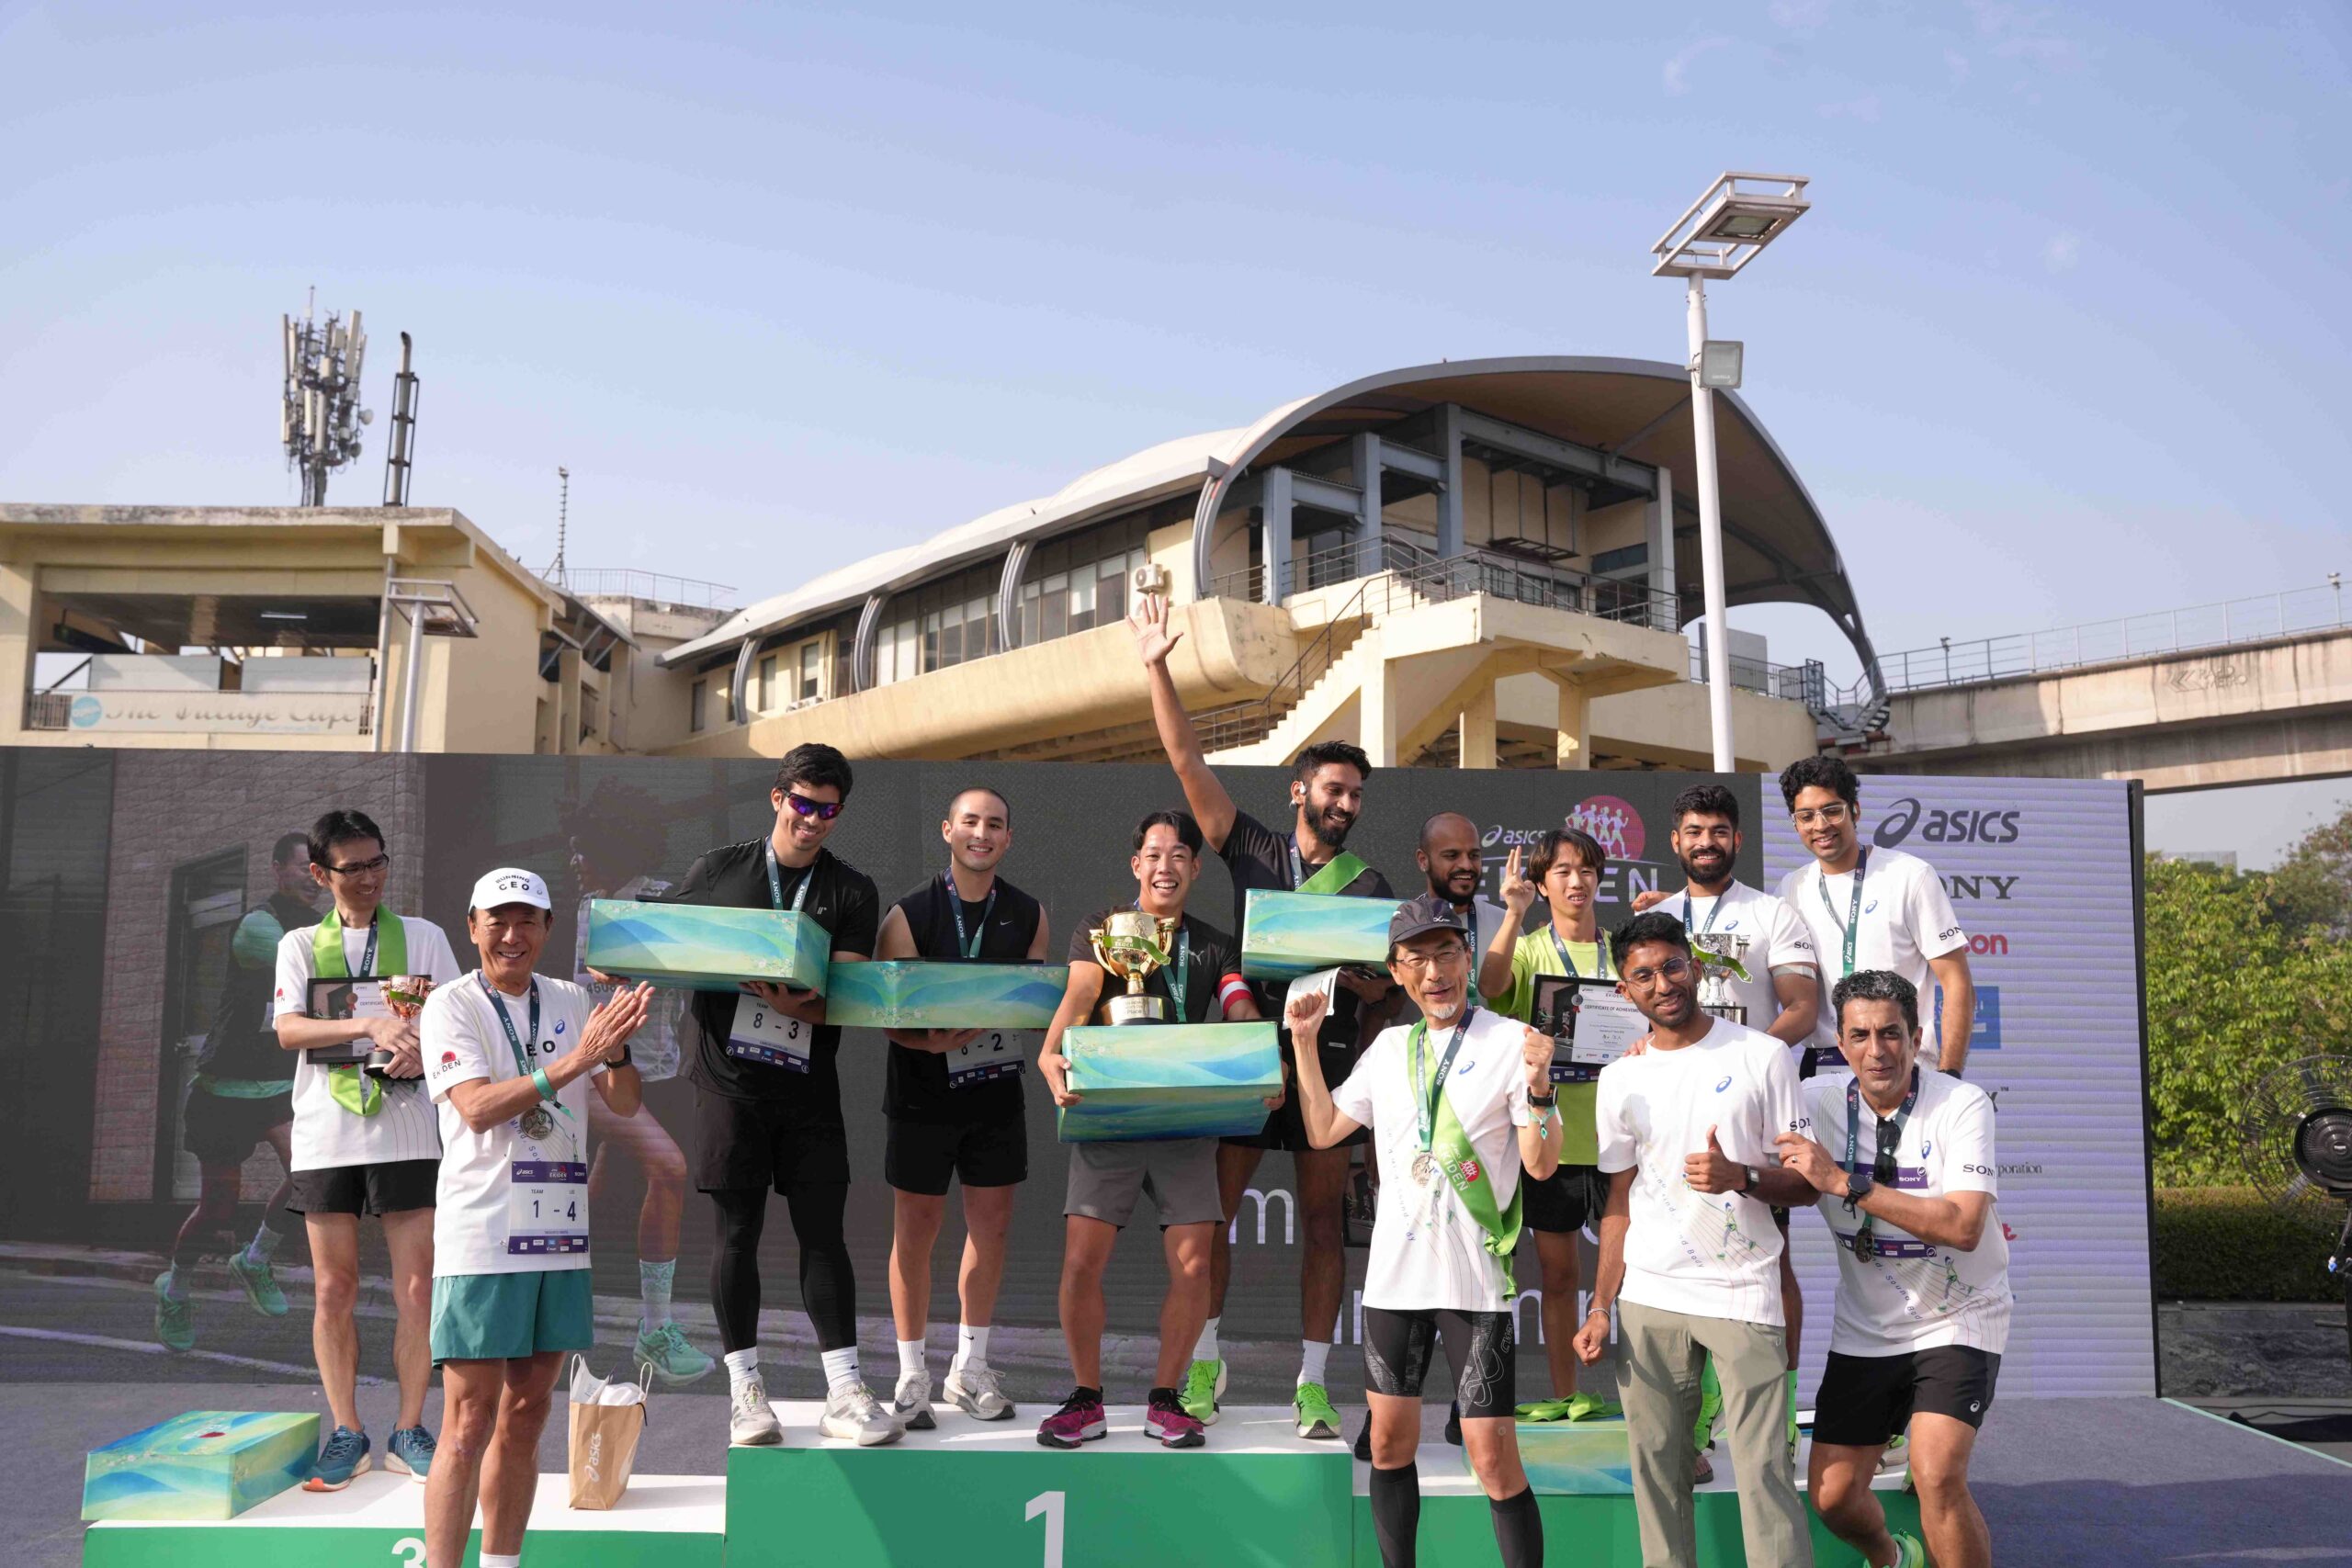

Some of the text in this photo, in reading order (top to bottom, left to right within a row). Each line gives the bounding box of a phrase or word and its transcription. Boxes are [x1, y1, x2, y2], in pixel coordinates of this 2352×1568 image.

[1922, 809, 2020, 843] asics
[495, 874, 530, 884] RUNNING
[499, 881, 530, 891] CEO
[1939, 875, 2019, 899] NY
[794, 884, 806, 908] SONY
[1849, 898, 1858, 924] SONY
[1939, 926, 1962, 941] SON
[1793, 941, 1815, 950] SON
[1964, 934, 2008, 955] on
[363, 948, 373, 971] SONY
[753, 1012, 763, 1029] 8
[788, 1021, 799, 1039] 3
[991, 1033, 1003, 1051] 2
[1435, 1058, 1450, 1086] SONY
[1790, 1117, 1810, 1132] SO
[1962, 1164, 1995, 1179] SON
[1996, 1161, 2042, 1178] poration
[533, 1200, 539, 1218] 1
[567, 1201, 576, 1222] 4
[1907, 1305, 1923, 1321] Bod
[588, 1432, 602, 1467] asics
[1025, 1491, 1066, 1568] 1
